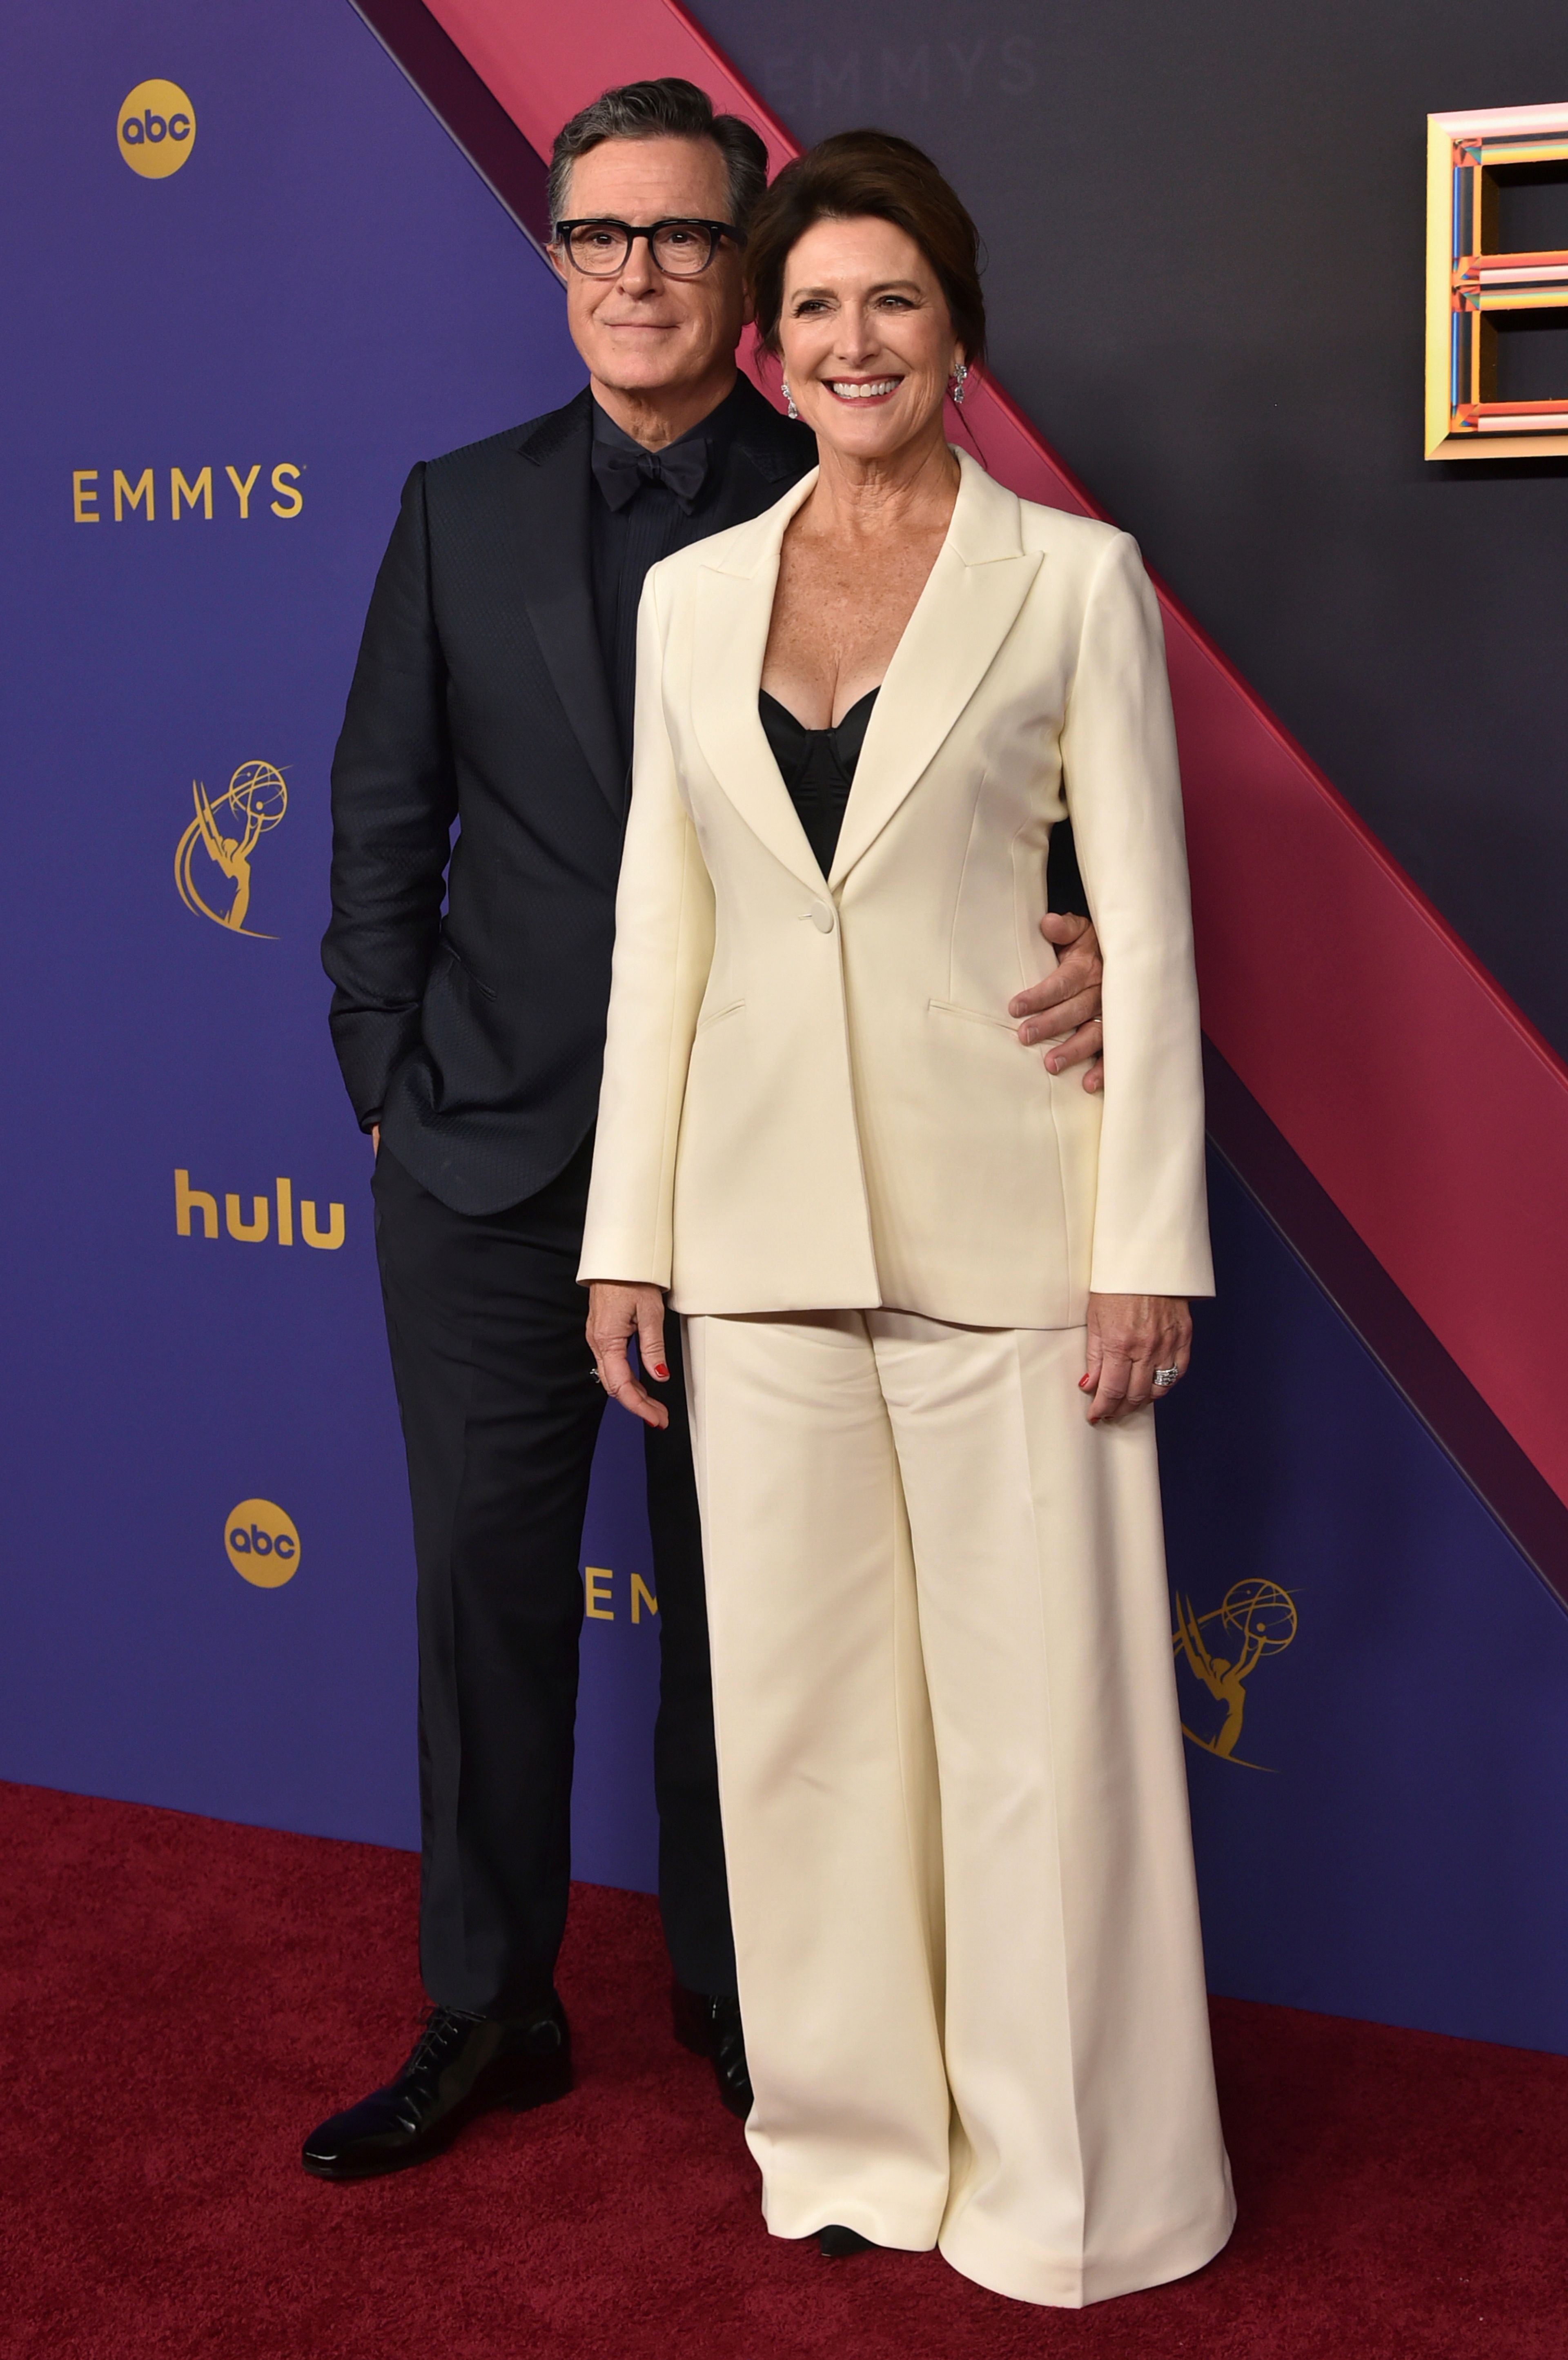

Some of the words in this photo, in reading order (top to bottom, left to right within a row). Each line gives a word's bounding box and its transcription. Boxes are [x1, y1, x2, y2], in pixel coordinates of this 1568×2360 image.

[764, 34, 1036, 111] EMMYS
[122, 109, 190, 145] abc
[73, 463, 303, 522] EMMYS
[174, 1168, 345, 1250] hulu
[230, 1524, 295, 1560] abc
